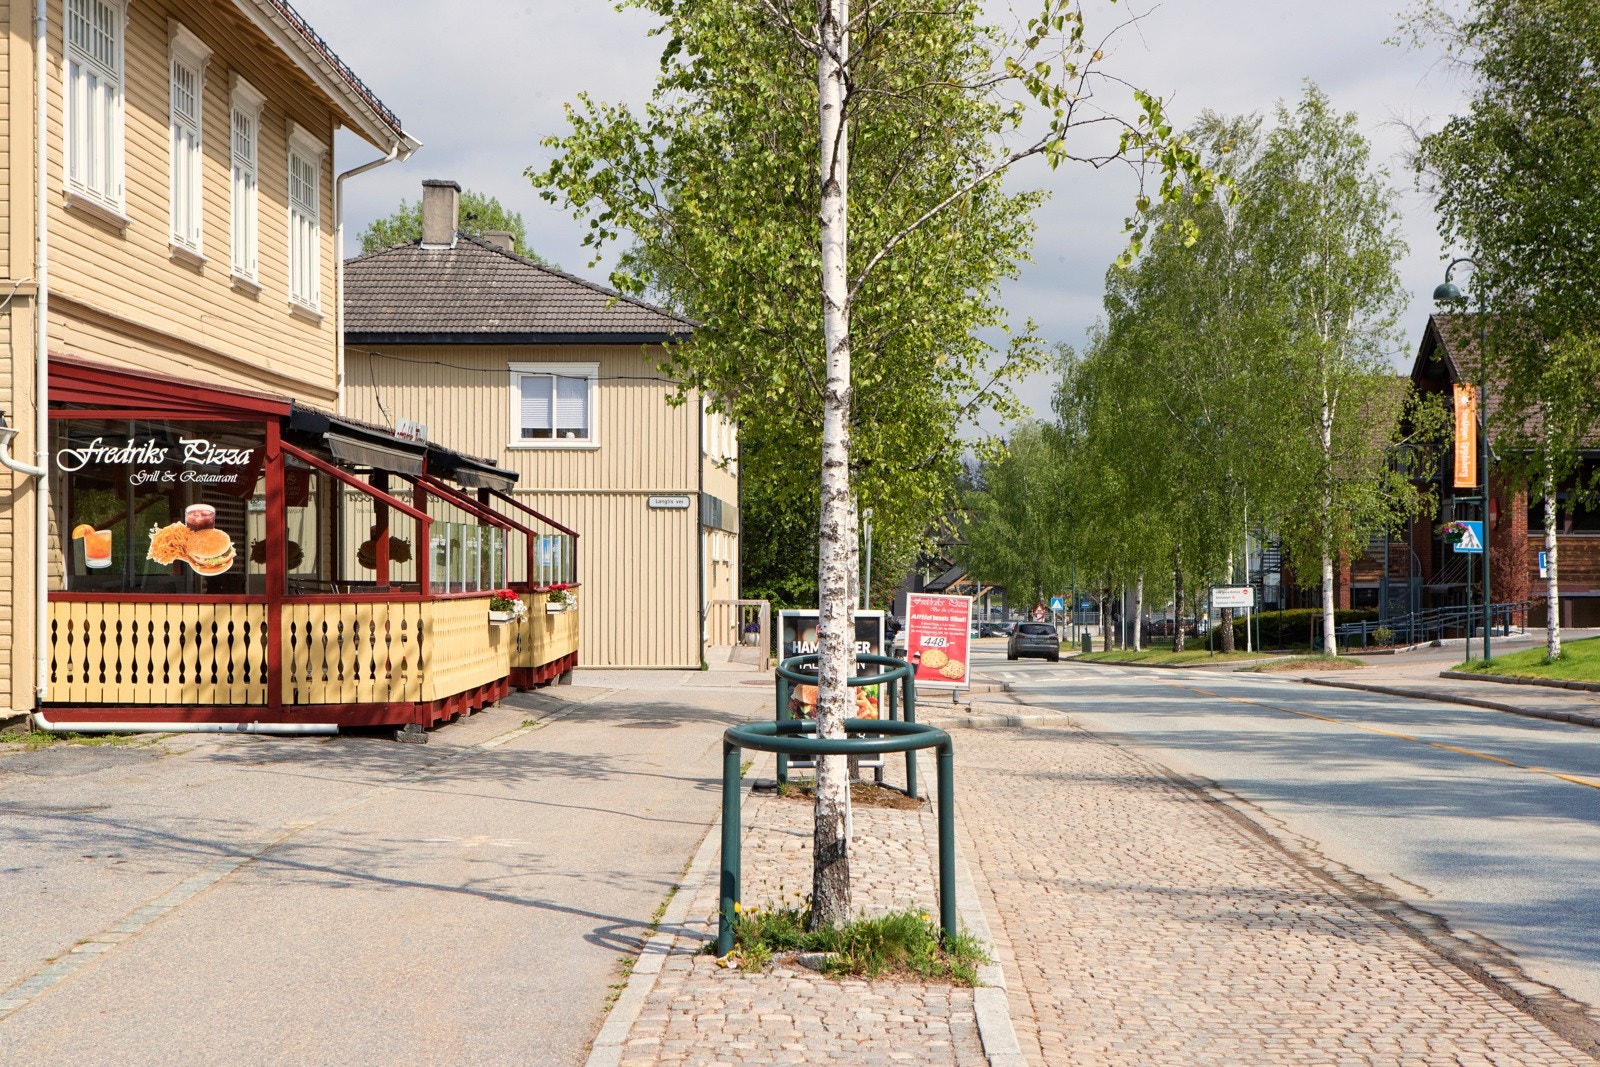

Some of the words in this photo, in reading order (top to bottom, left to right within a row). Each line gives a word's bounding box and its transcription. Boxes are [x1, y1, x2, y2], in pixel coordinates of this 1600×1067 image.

[56, 437, 169, 472] Fredriks
[179, 437, 254, 465] Pizza
[129, 470, 159, 486] Grill
[161, 472, 176, 482] &
[179, 470, 238, 484] Restaurant
[911, 613, 932, 621] Alltid
[792, 640, 871, 654] HAMER
